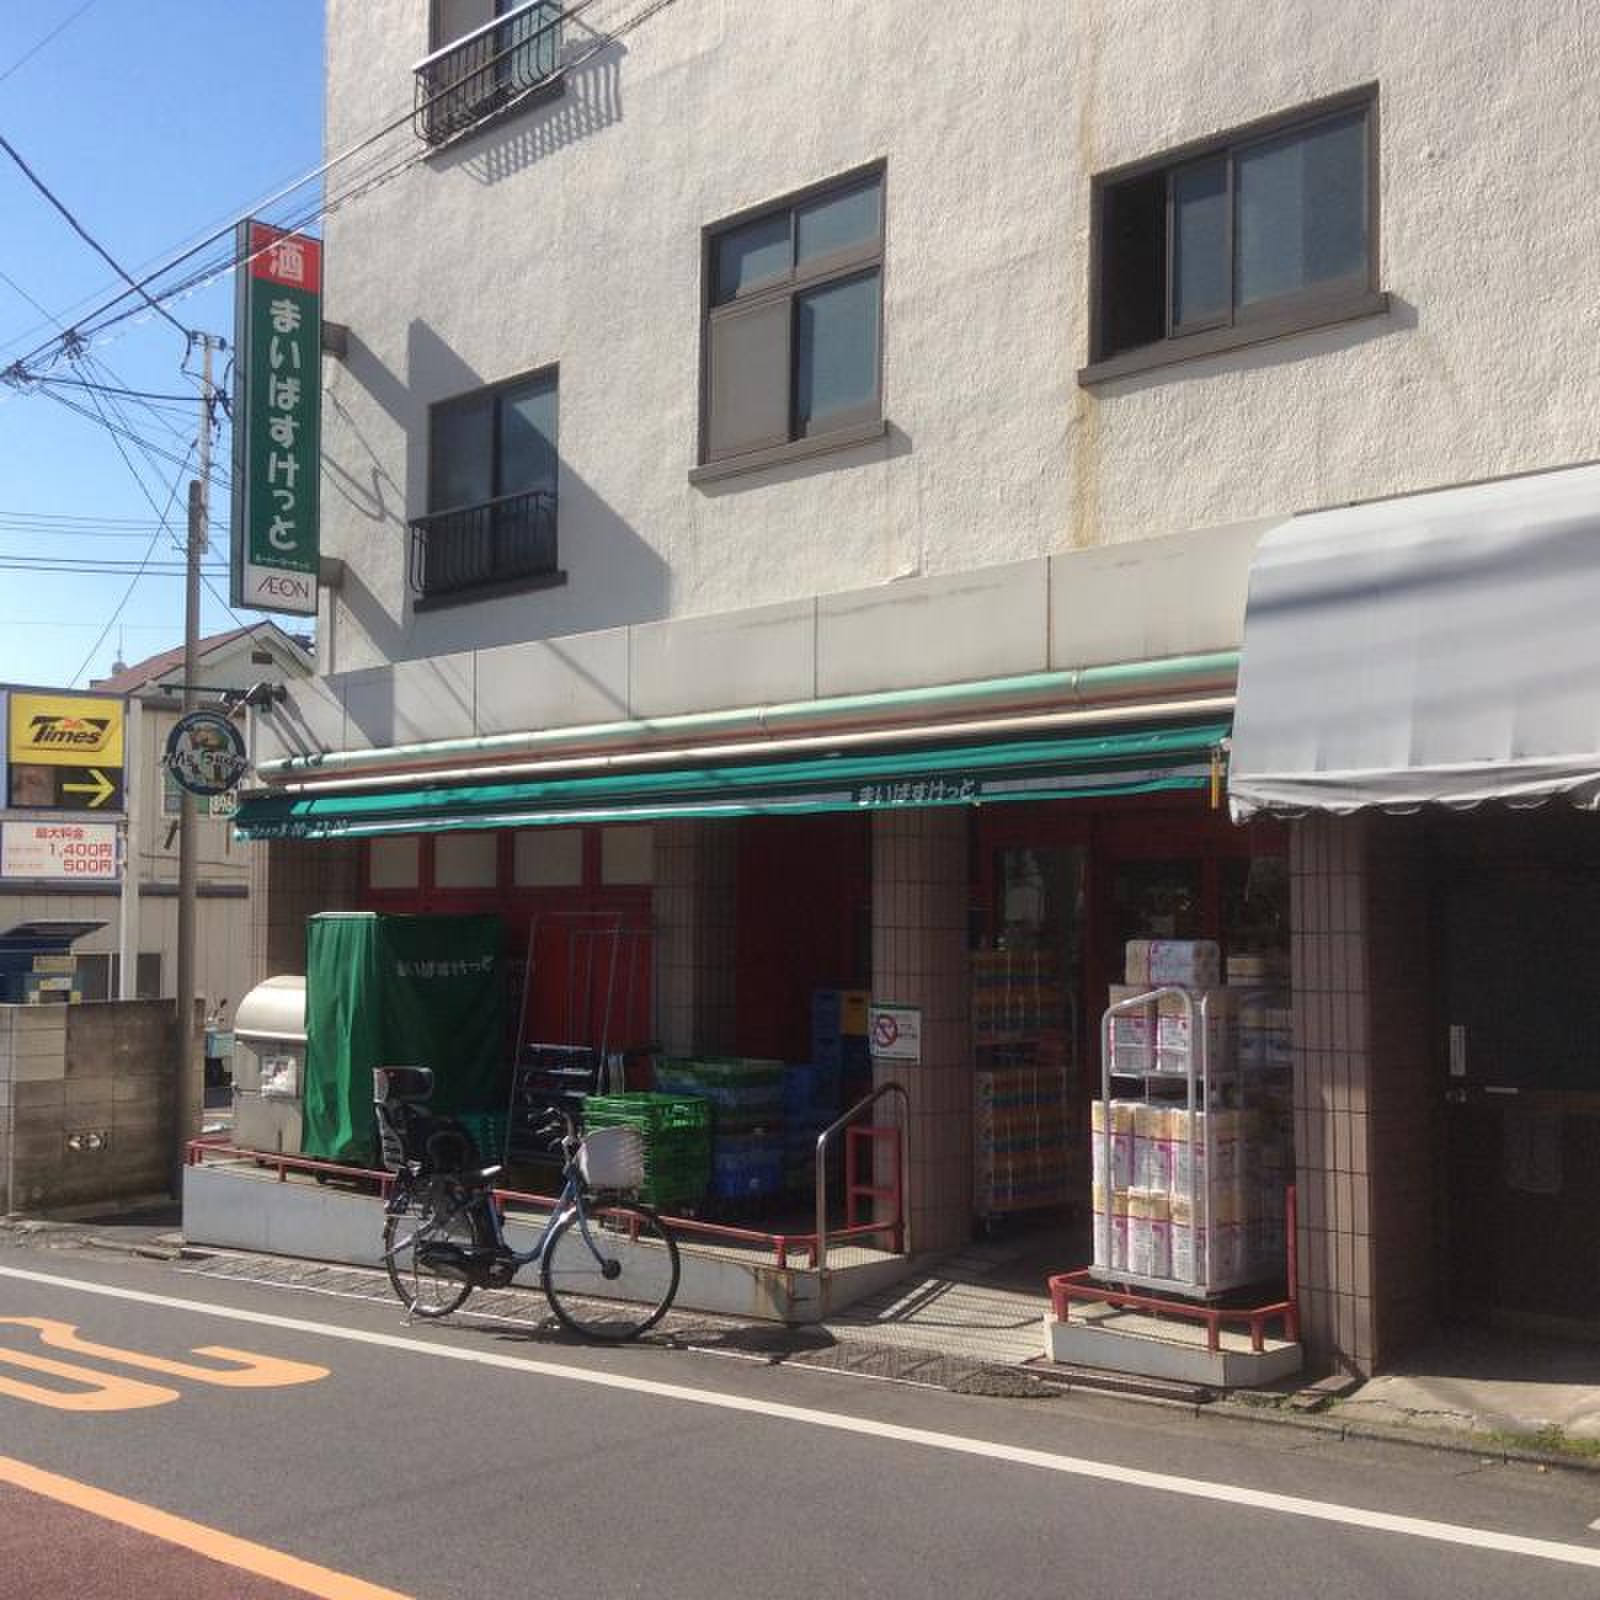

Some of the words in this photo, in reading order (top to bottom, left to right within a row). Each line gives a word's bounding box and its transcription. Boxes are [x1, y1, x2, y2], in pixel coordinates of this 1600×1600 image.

[269, 239, 305, 283] 酒
[267, 298, 302, 551] まいばすけっと
[30, 716, 109, 744] Times
[857, 778, 977, 806] まいばすけっと
[49, 842, 113, 859] 1,400円
[63, 859, 113, 874] 500円
